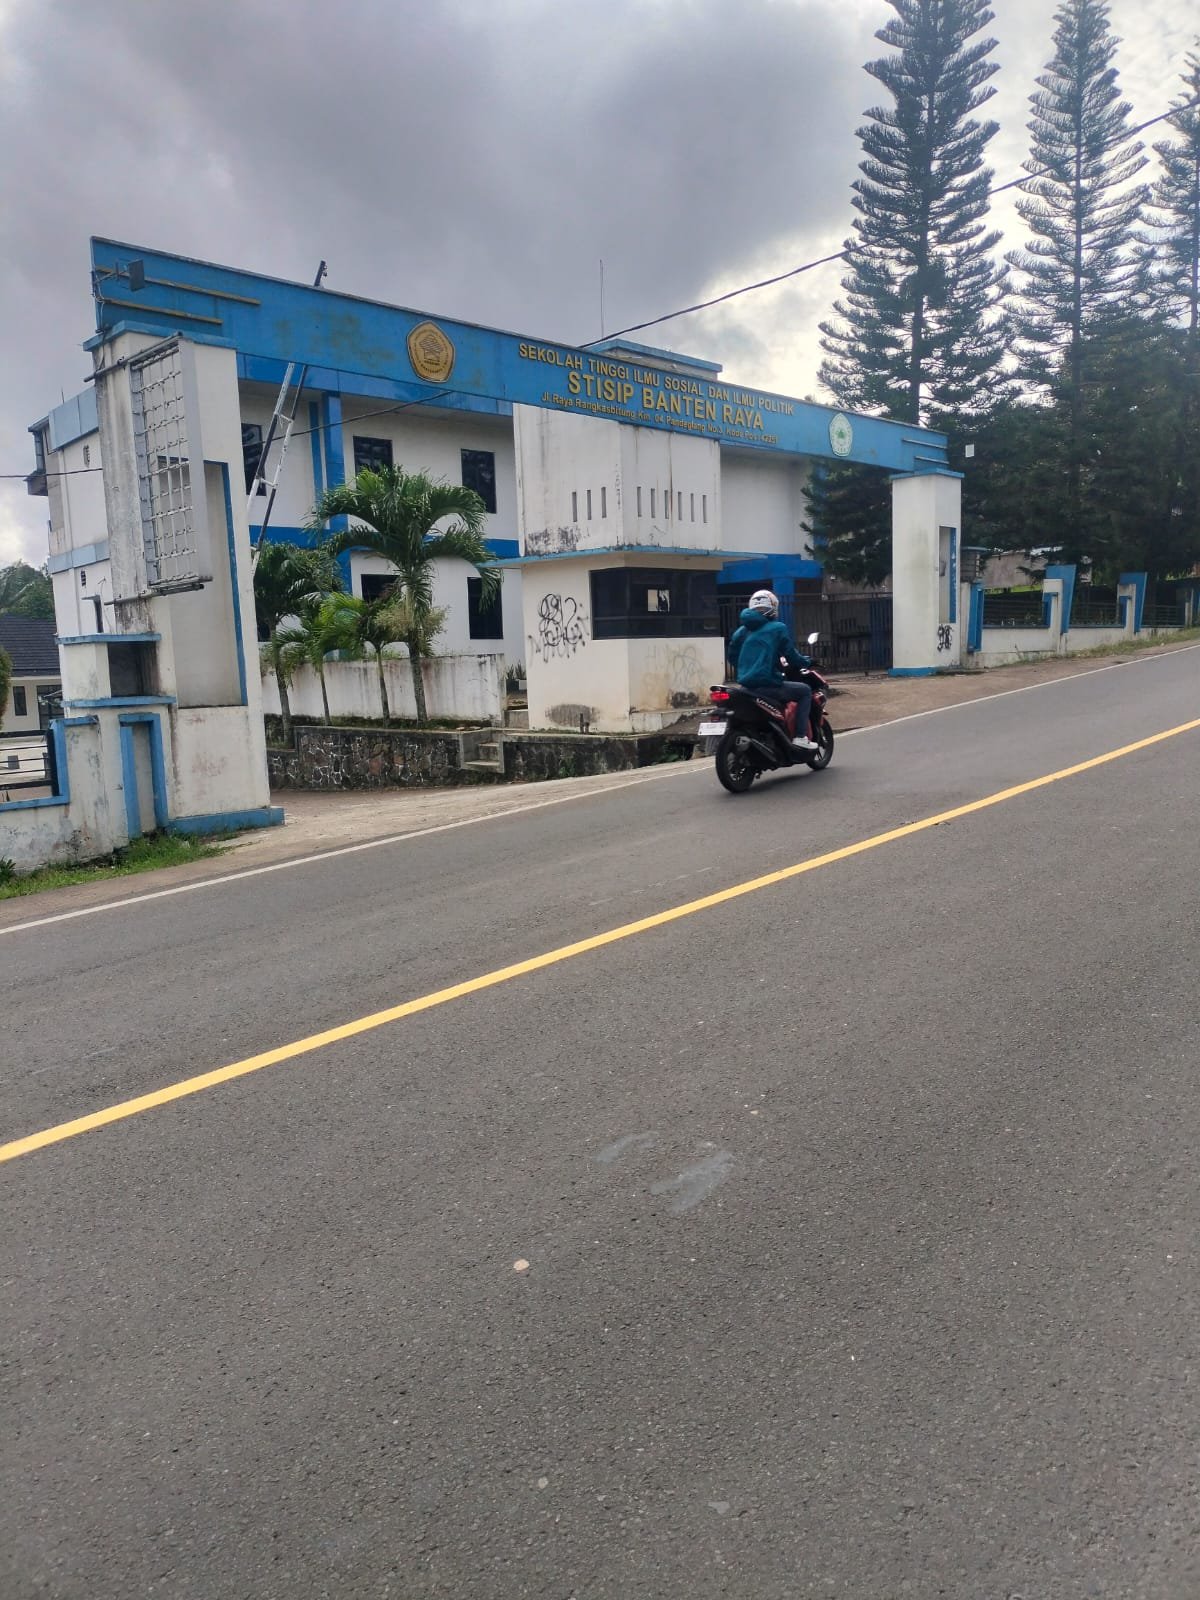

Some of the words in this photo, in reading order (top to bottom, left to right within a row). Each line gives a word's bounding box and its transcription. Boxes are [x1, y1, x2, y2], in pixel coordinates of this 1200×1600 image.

[519, 343, 583, 369] SEKOLAH
[589, 358, 629, 379] TINGGI
[633, 369, 660, 386] ILMU
[664, 376, 704, 396] SOSIAL
[708, 386, 730, 401] DAN
[733, 391, 755, 407] ILMU
[758, 397, 794, 415] POLITIK
[552, 393, 573, 407] Raya
[568, 371, 634, 404] STISIP
[642, 387, 717, 421] BANTEN
[723, 404, 764, 430] RAYA
